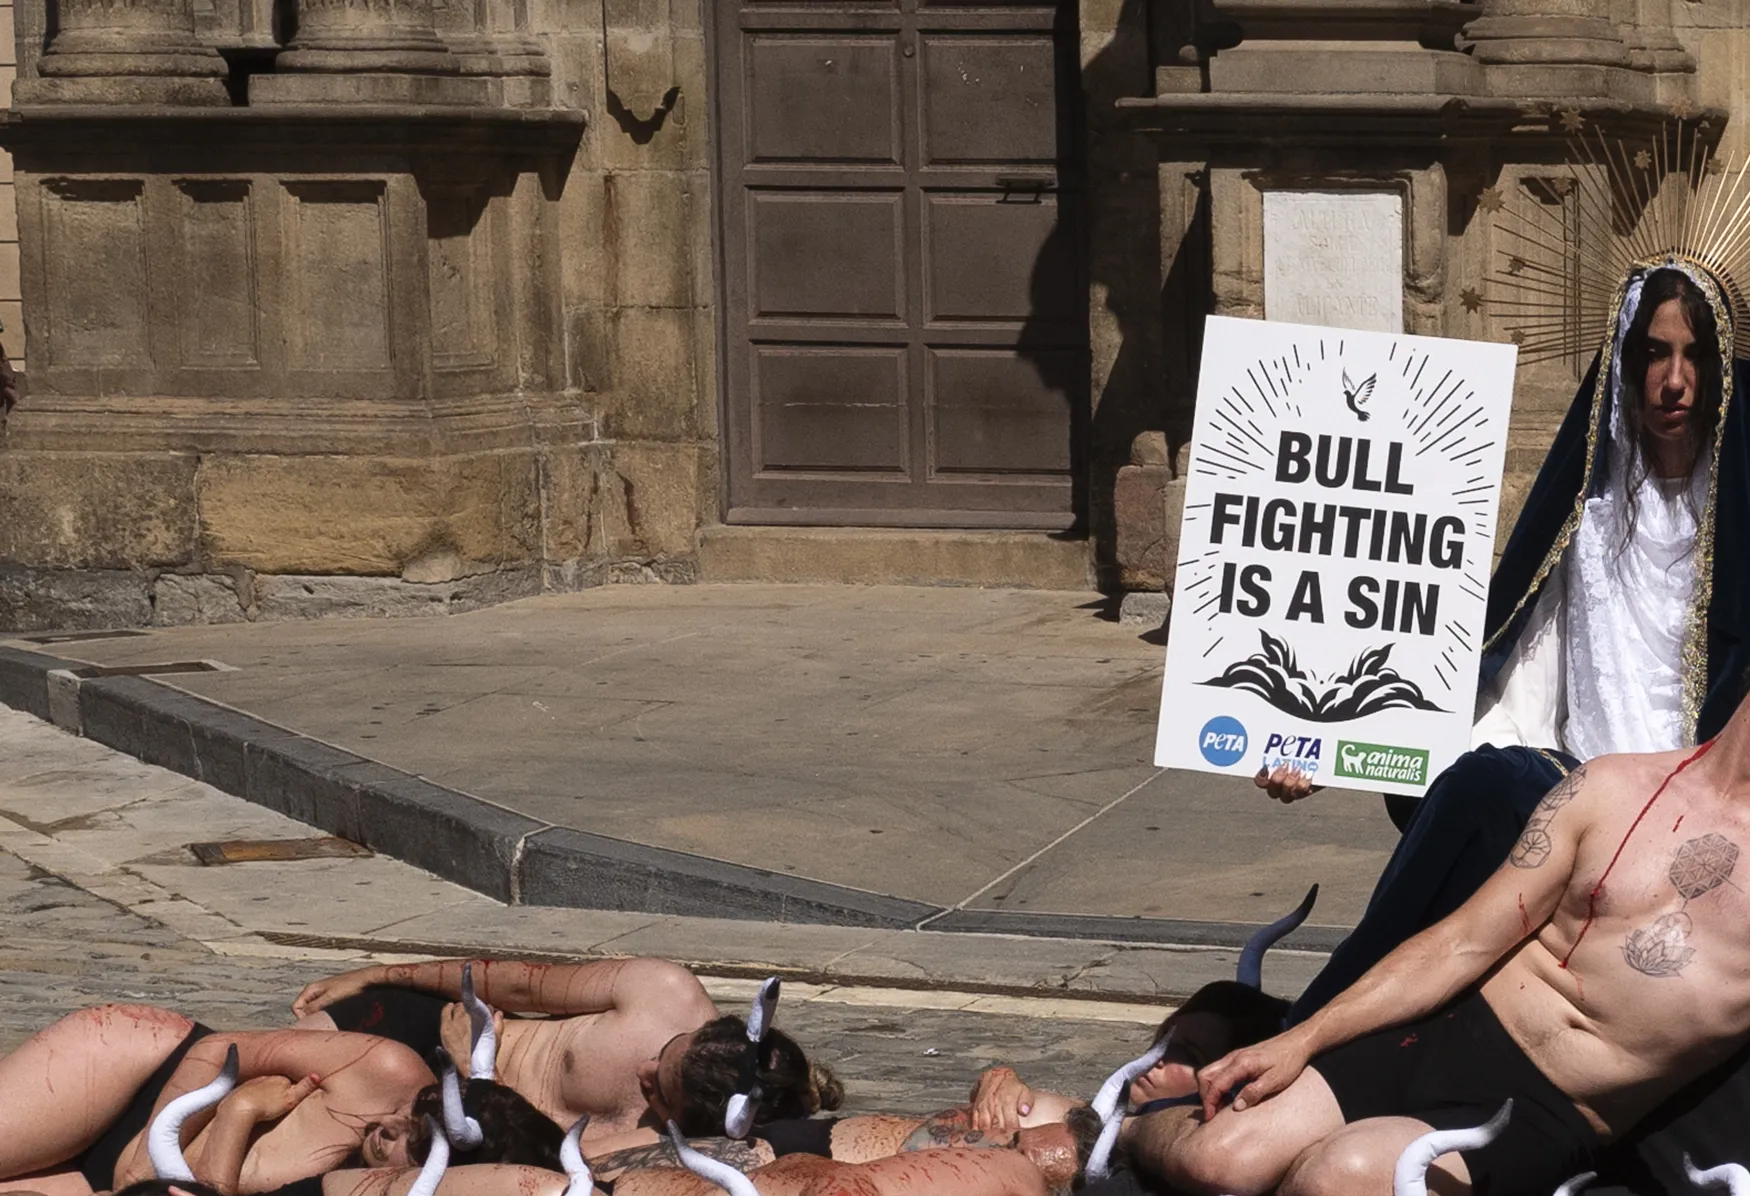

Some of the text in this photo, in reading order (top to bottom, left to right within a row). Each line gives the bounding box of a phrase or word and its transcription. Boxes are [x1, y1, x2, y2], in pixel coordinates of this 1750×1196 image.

[1275, 431, 1414, 496] BULL
[1209, 493, 1466, 570] FIGHTING
[1219, 563, 1440, 636] IS A SIN
[1365, 765, 1422, 782] naturalis
[1366, 749, 1424, 770] anima
